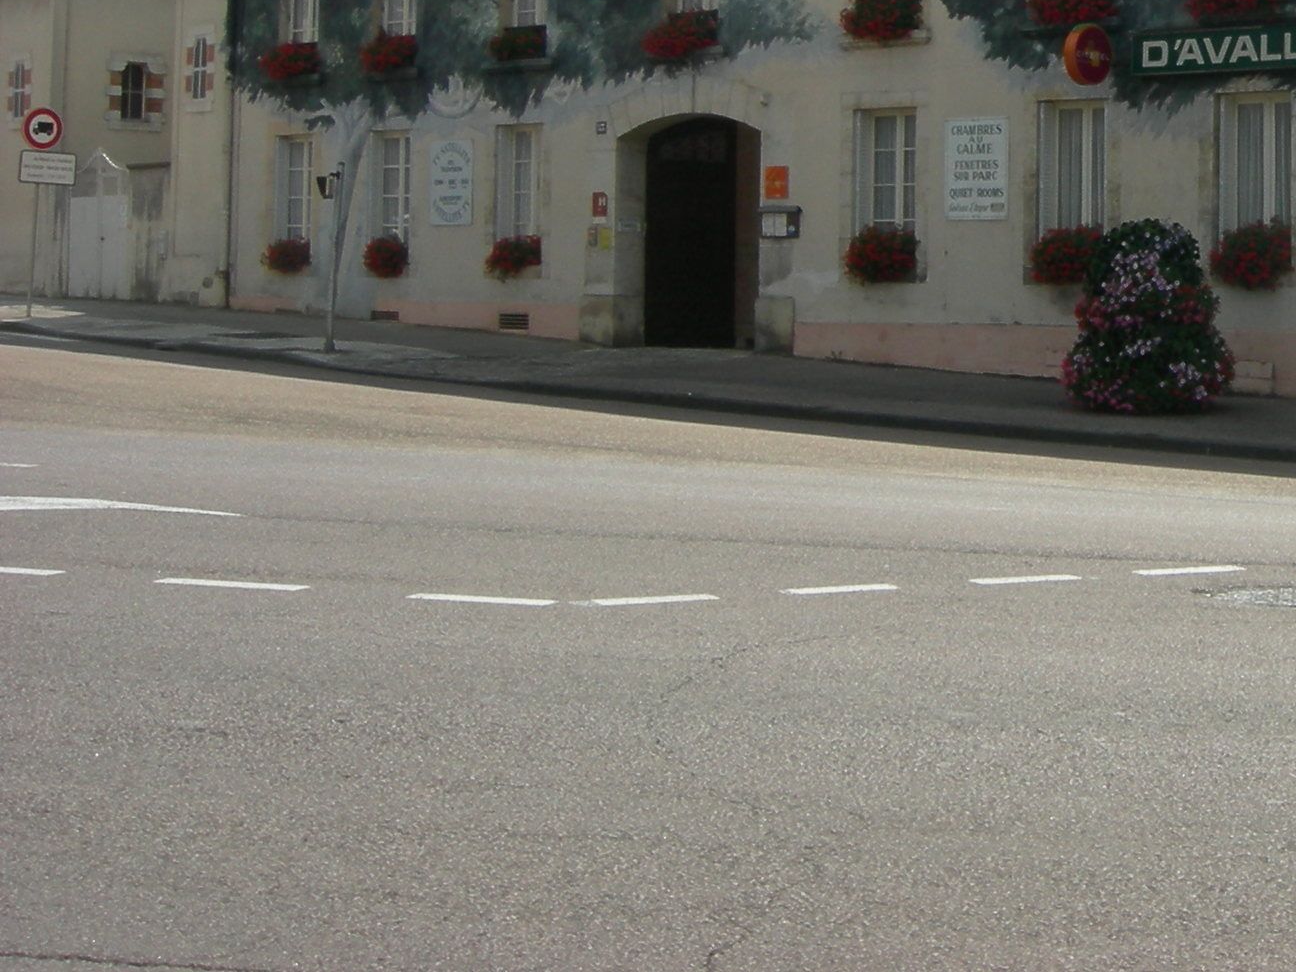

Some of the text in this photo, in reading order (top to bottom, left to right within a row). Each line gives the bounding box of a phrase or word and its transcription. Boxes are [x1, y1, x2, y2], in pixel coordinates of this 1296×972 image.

[951, 124, 1002, 136] CHAMBRES
[957, 143, 992, 155] CALME
[953, 171, 998, 181] SUR PARC
[949, 188, 1004, 199] QUIET ROOMS
